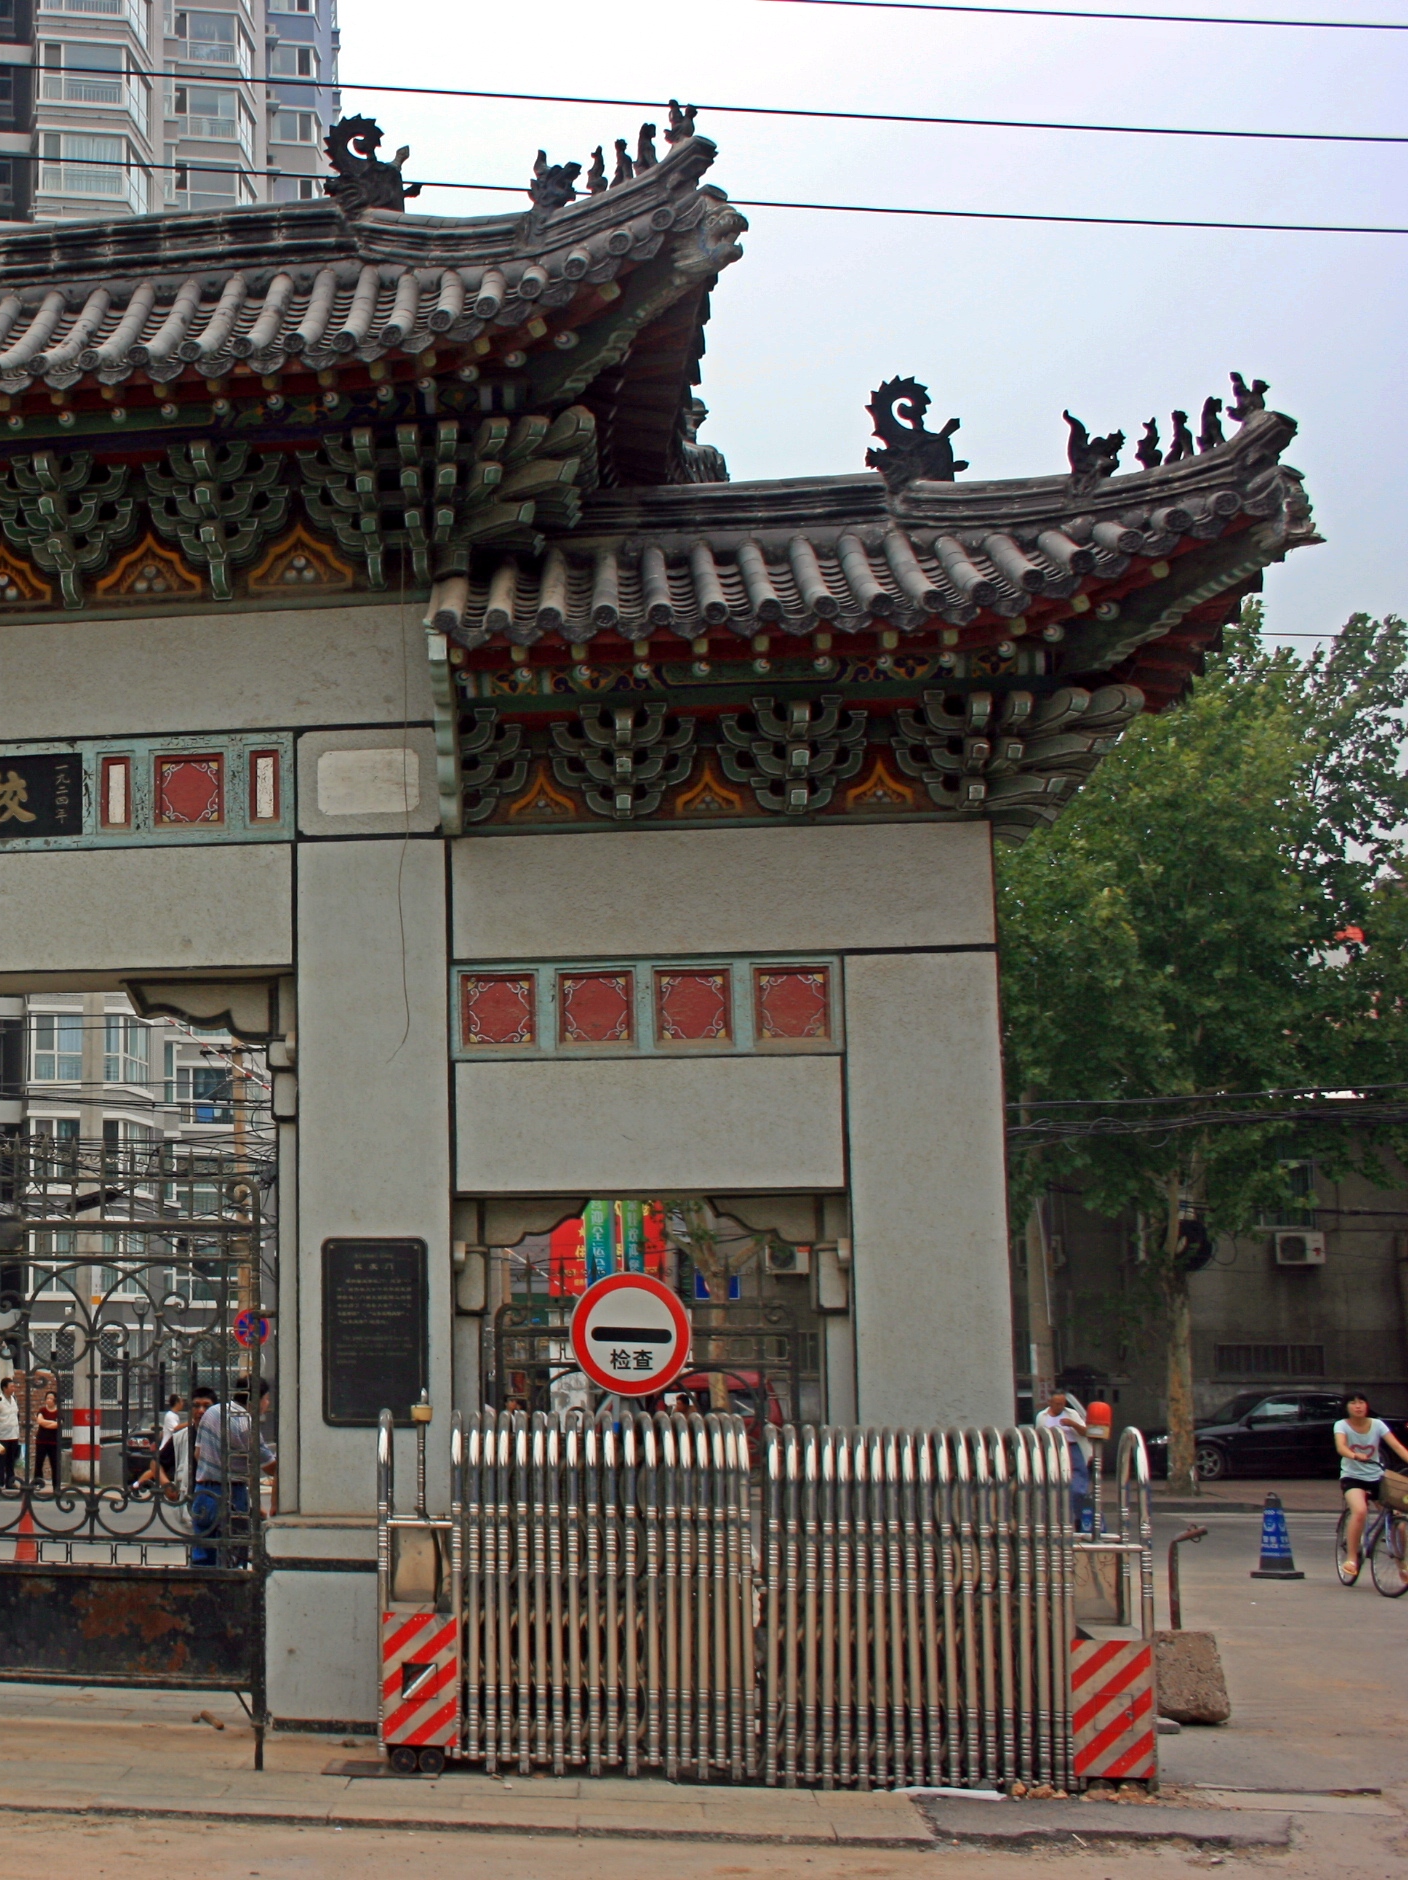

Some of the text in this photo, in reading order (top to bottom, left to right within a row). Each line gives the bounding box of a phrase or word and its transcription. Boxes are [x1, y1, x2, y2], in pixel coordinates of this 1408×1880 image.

[54, 764, 71, 824] 一九二四年
[609, 1348, 654, 1371] 检查
